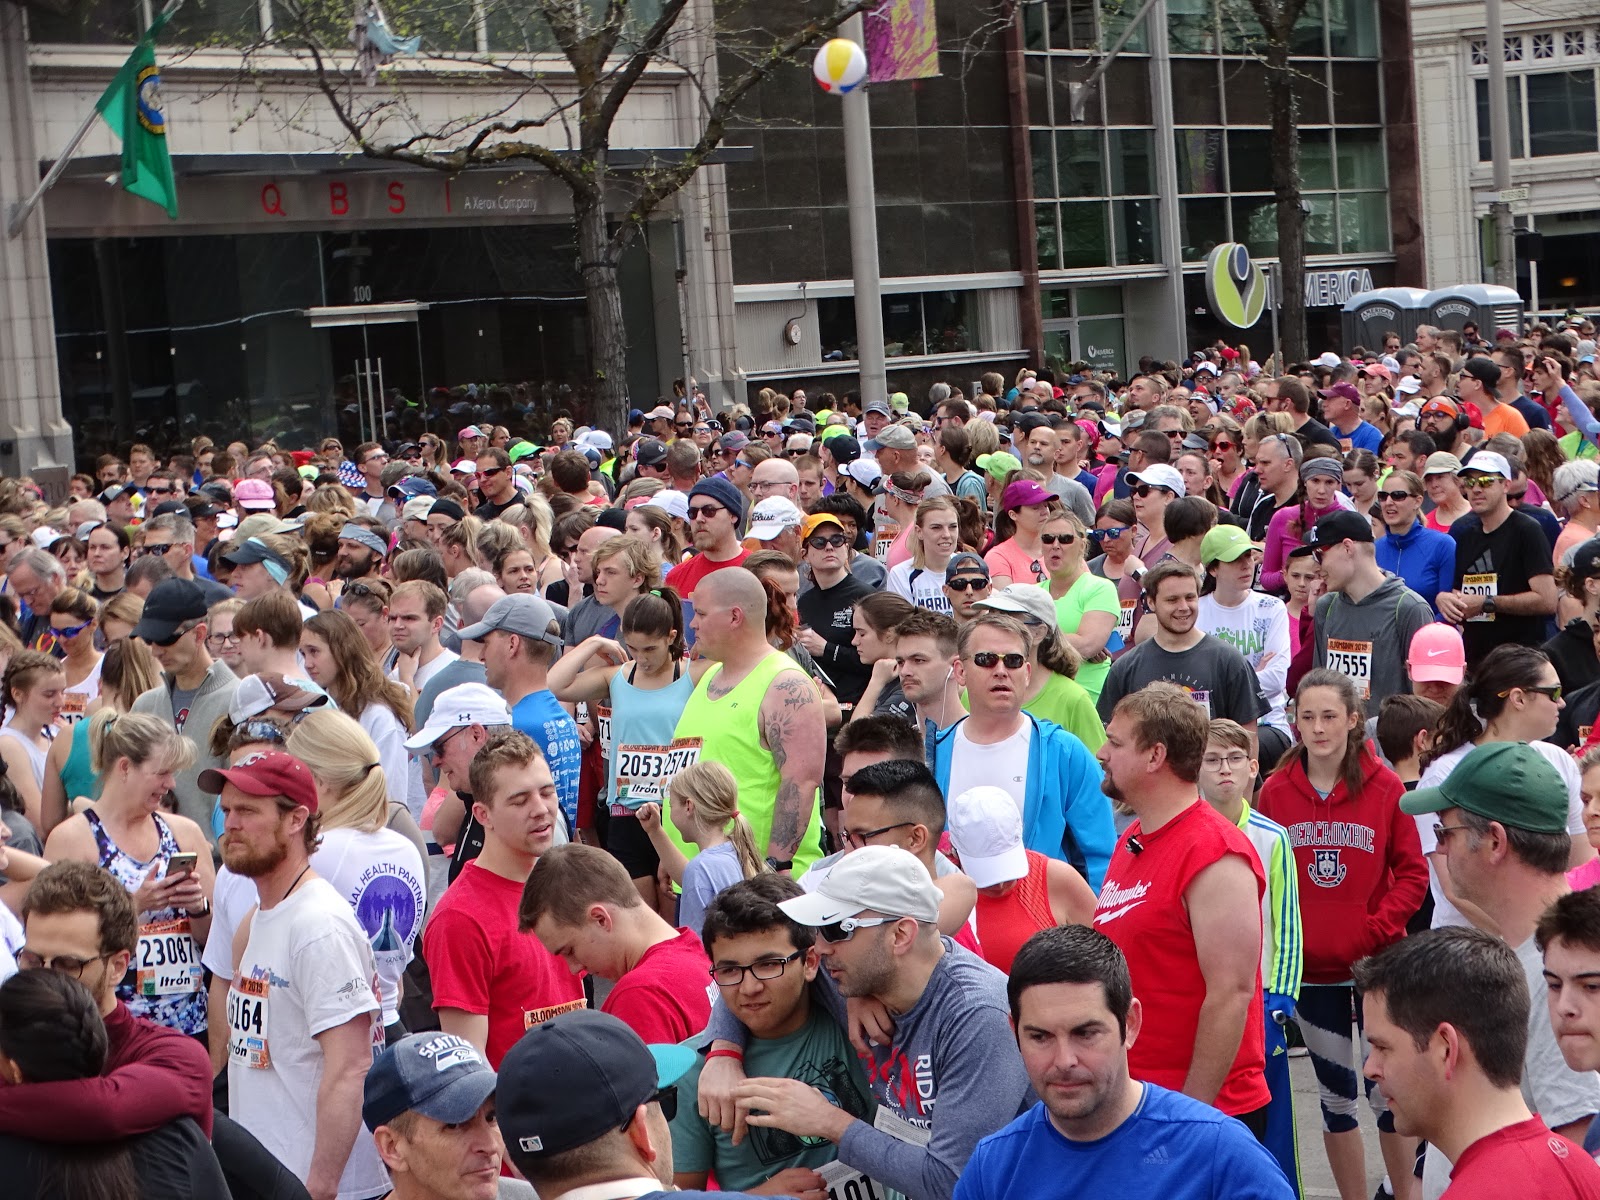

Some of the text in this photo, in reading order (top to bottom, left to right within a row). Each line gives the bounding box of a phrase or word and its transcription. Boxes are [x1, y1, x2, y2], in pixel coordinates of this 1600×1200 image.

[464, 195, 538, 213] A Xerox Company
[353, 285, 372, 302] 100
[359, 862, 396, 885] HEALTH
[140, 936, 194, 968] 23087
[249, 979, 263, 994] 2019
[914, 1054, 937, 1115] RIDE
